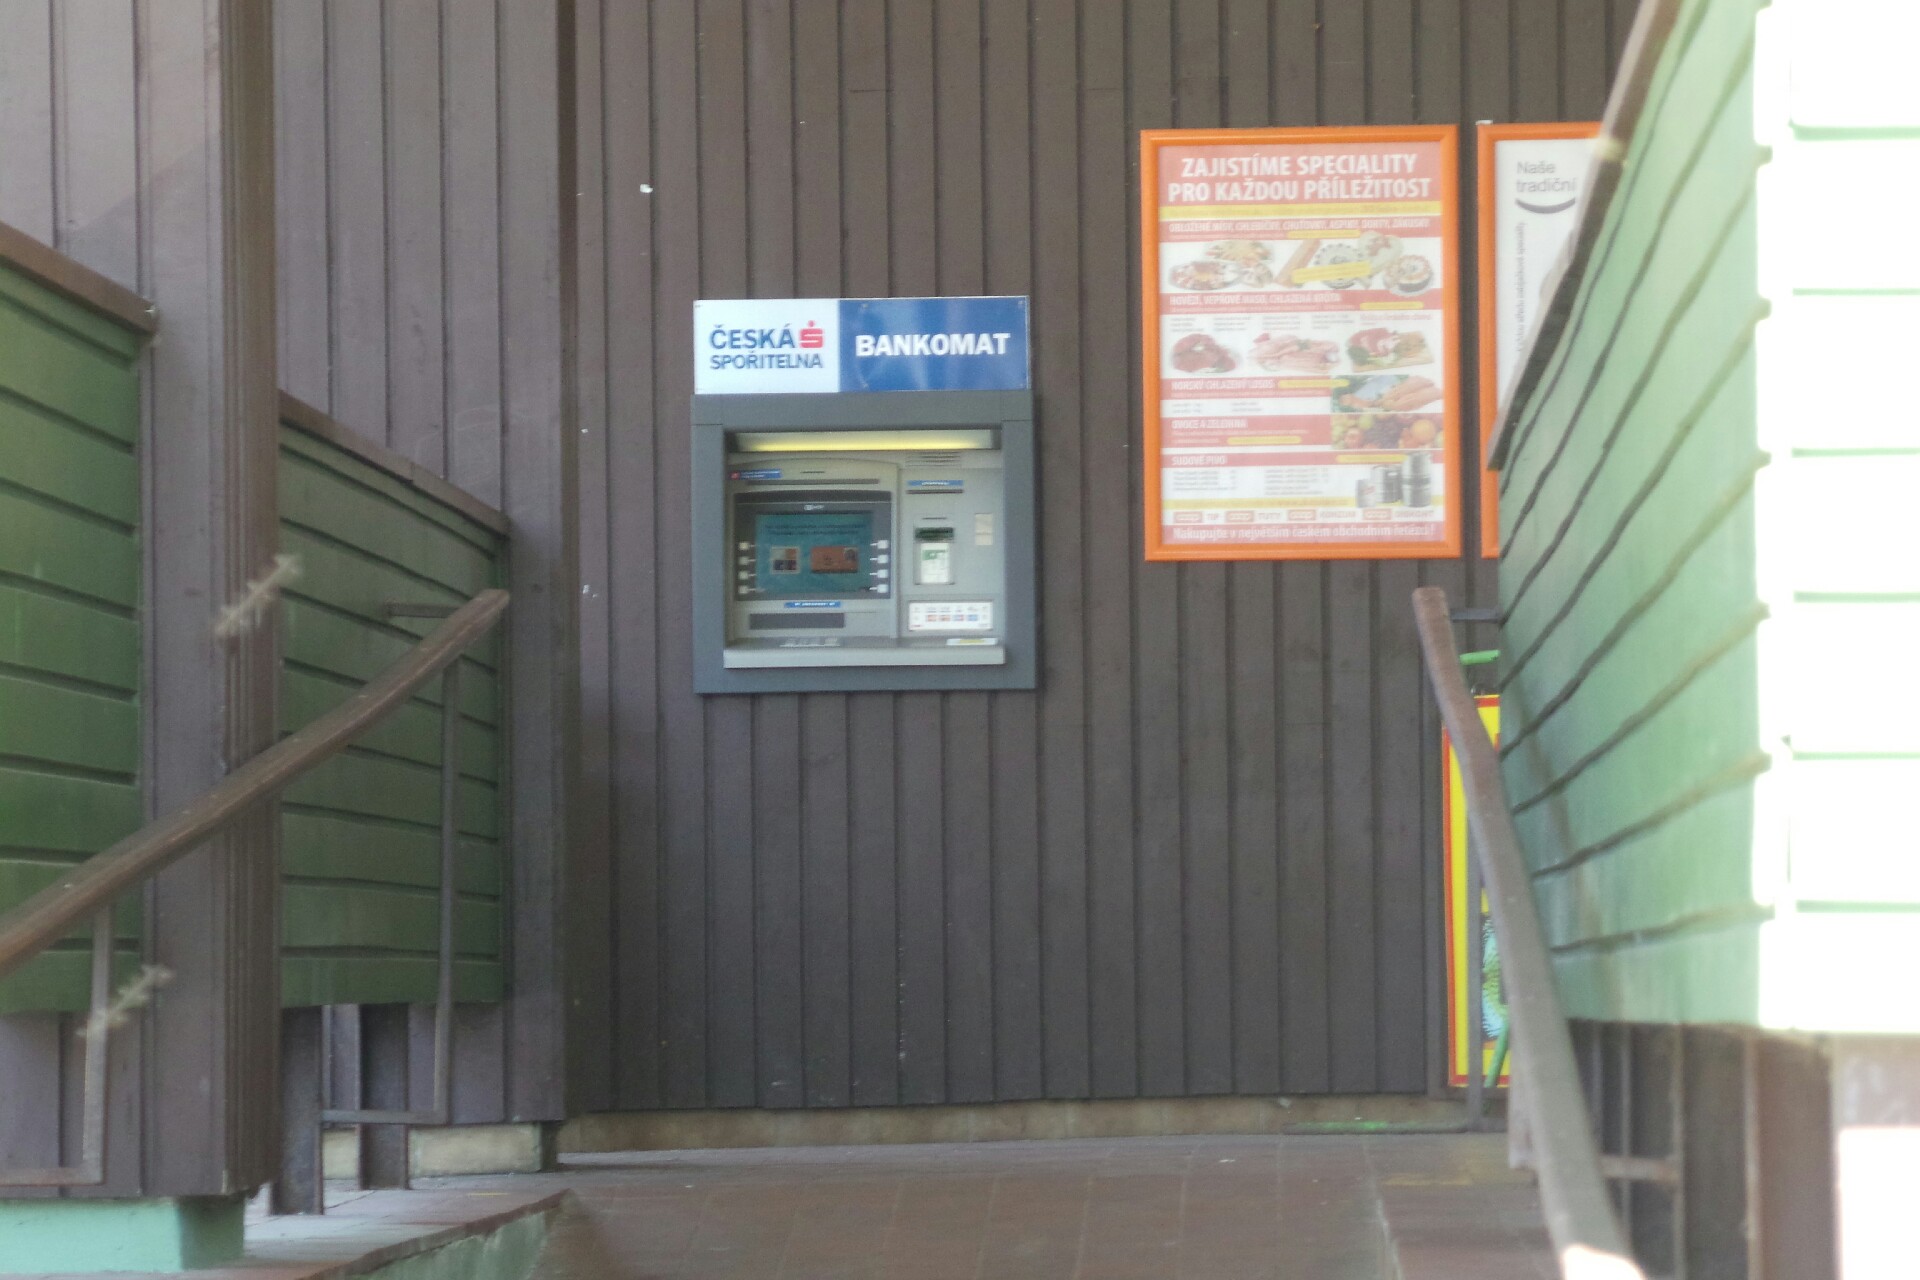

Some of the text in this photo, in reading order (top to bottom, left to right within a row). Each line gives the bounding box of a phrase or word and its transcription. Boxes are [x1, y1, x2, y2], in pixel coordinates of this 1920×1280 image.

[1181, 153, 1418, 178] ZAJISTÍME SPECIALITY
[1516, 160, 1556, 174] Naše
[1168, 175, 1432, 202] PRO KAŽDOU PŘÍLEŽITOST
[1516, 177, 1577, 192] tradiční
[709, 323, 796, 349] ČESKÁ
[855, 333, 1010, 357] BANKOMAT
[710, 350, 823, 370] SPOŘITELNA
